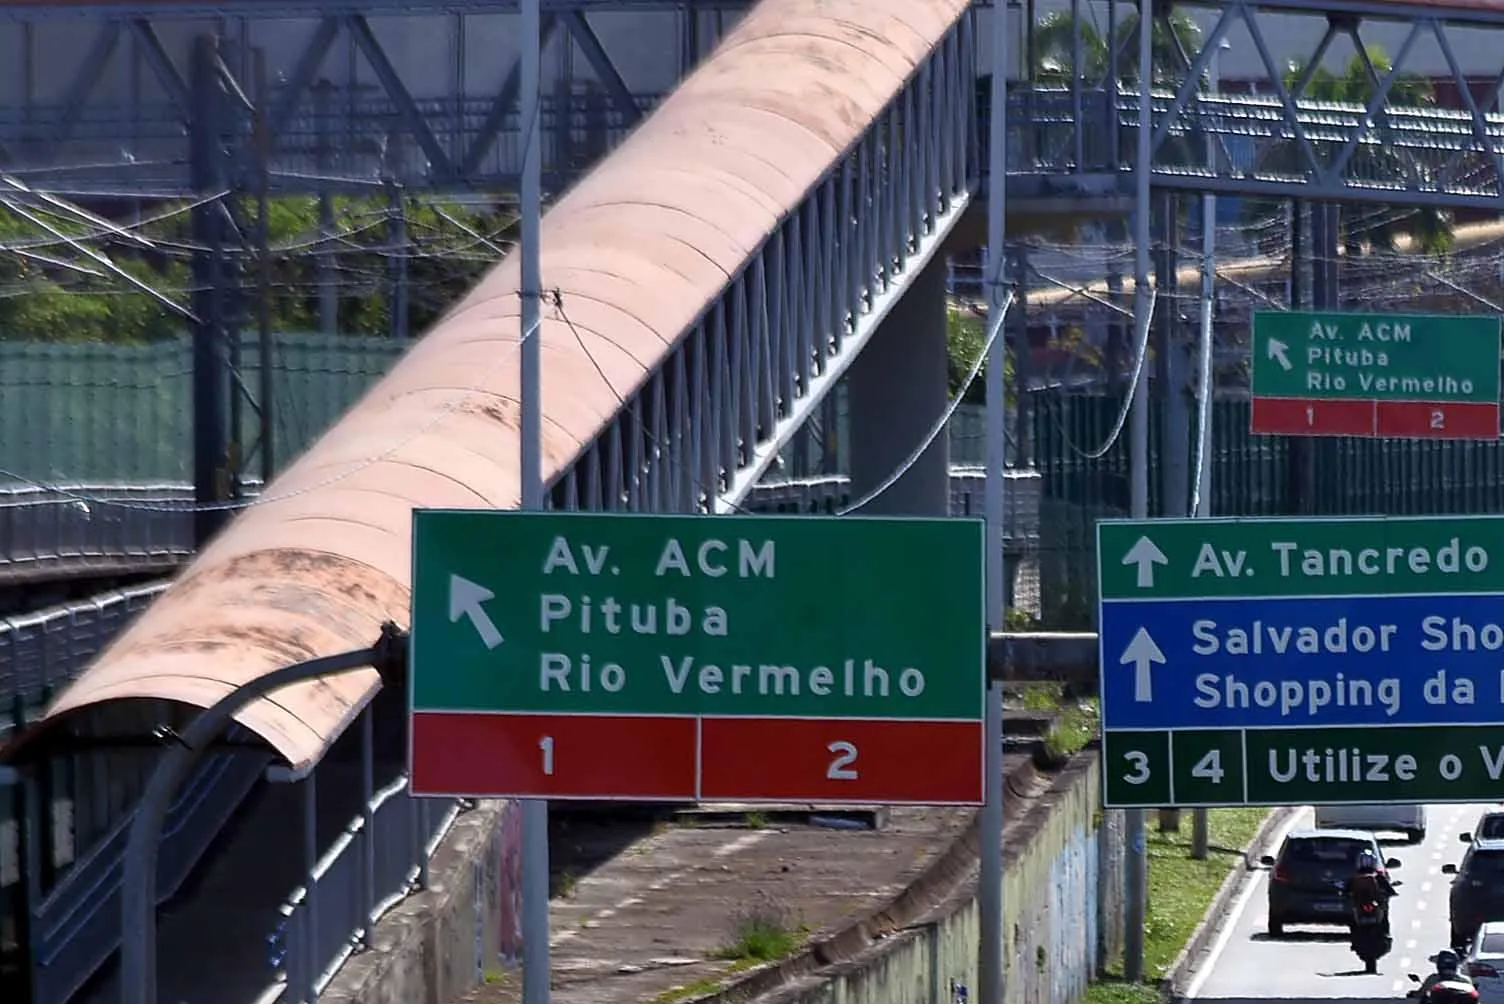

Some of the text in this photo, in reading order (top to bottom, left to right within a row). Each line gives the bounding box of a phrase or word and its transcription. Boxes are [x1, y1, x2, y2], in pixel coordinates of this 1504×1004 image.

[1310, 322, 1410, 341] Av. ACM
[1308, 348, 1388, 366] Pituba
[1307, 371, 1473, 393] Rio Vermelho
[1307, 408, 1313, 425] 1
[1431, 411, 1444, 428] 2
[544, 536, 774, 578] Av. ACM
[1192, 544, 1254, 577] Av.
[1272, 538, 1488, 576] Tancredo
[541, 594, 727, 635] Pituba
[1193, 618, 1397, 655] Salvador
[541, 653, 924, 696] Rio Vermelho
[1194, 673, 1400, 715] Shopping
[1424, 670, 1474, 704] da
[540, 737, 553, 774] 1
[827, 741, 858, 779] 2
[1123, 751, 1150, 784] 3
[1192, 750, 1224, 783] 4
[1269, 748, 1417, 782] Utilize
[1440, 754, 1462, 780] o
